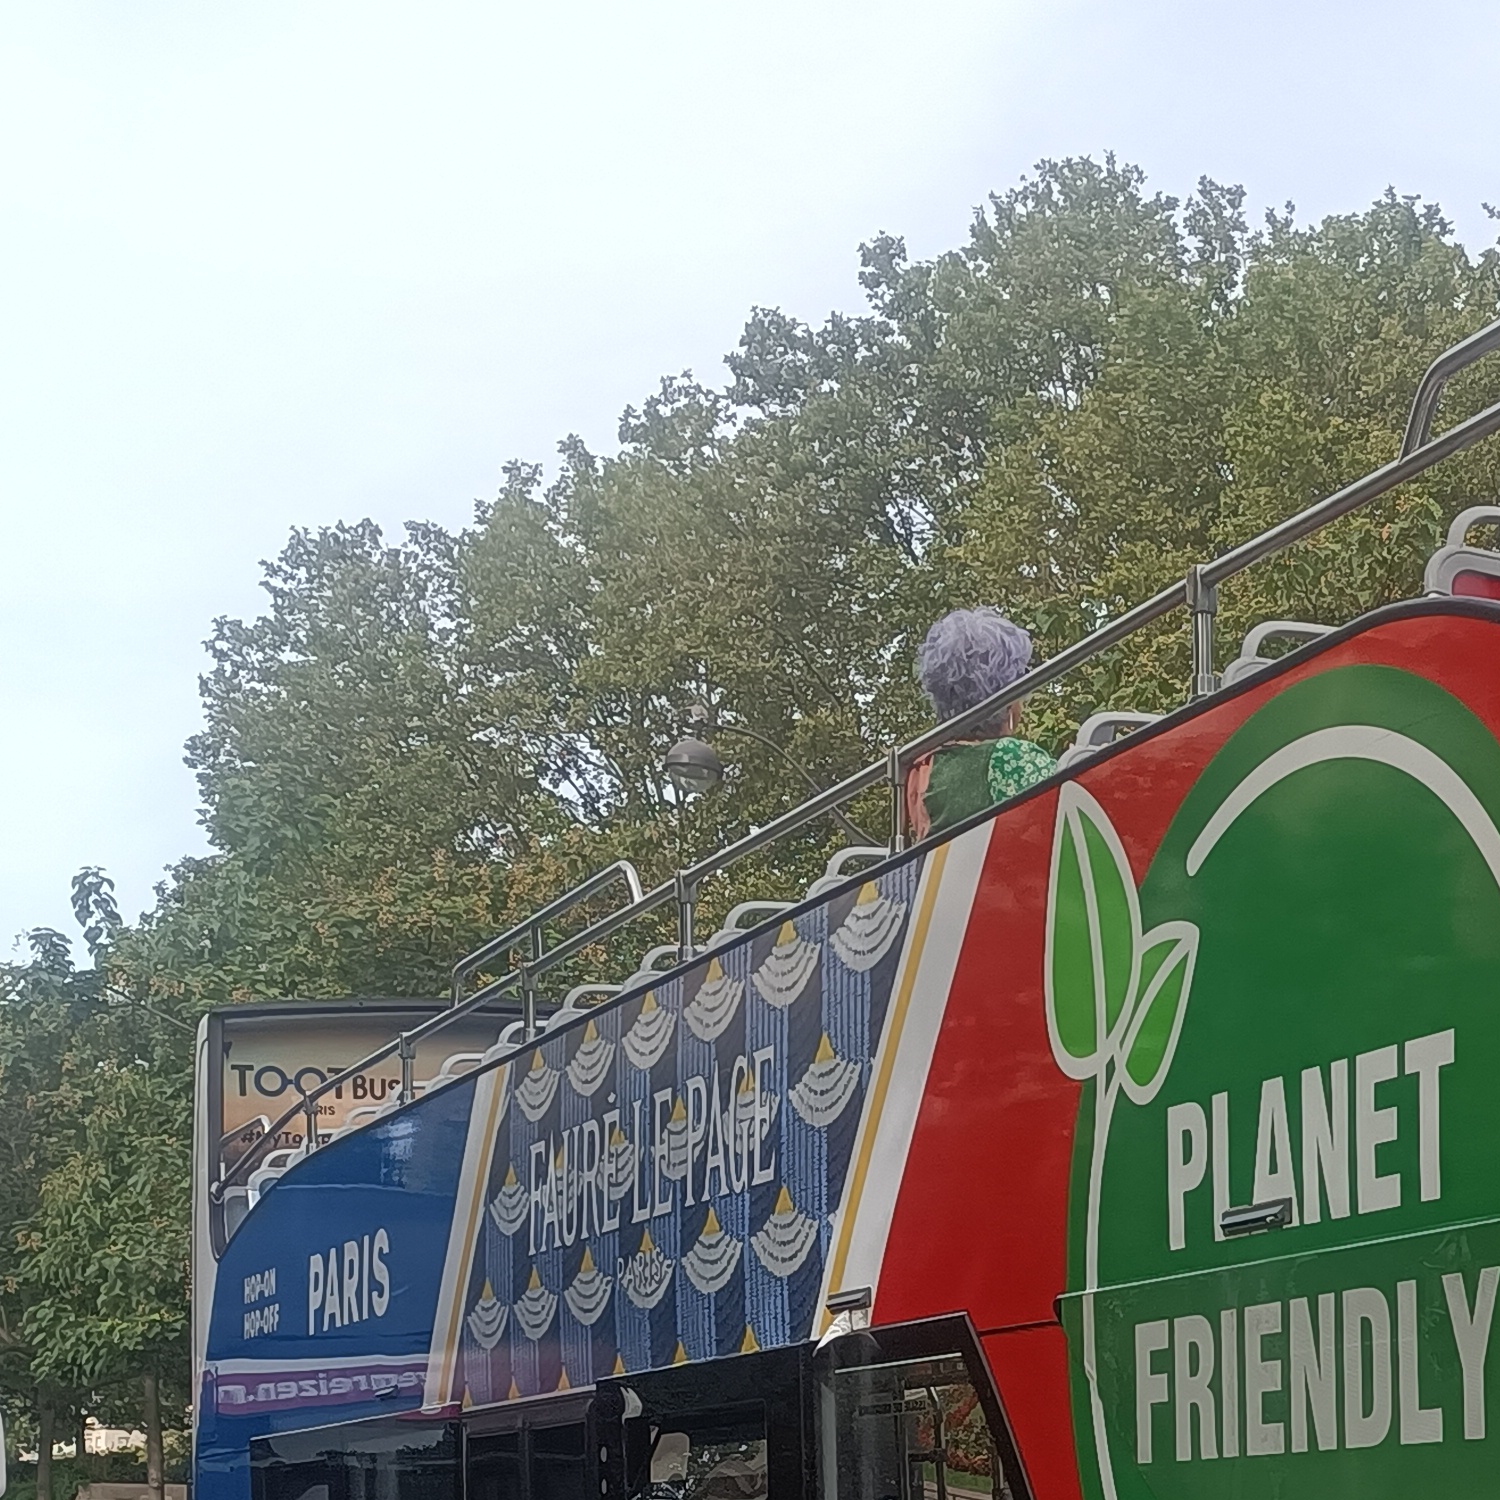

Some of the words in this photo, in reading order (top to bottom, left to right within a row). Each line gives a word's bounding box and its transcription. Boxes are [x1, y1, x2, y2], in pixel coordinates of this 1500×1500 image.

[631, 1084, 673, 1224] LE
[684, 1043, 777, 1207] PAGE
[1167, 1028, 1455, 1250] PLANET
[244, 1267, 277, 1304] HOP-ON
[244, 1303, 280, 1340] HOP-OFF
[308, 1228, 390, 1336] PARIS
[1134, 1265, 1500, 1464] FRIENDLY
